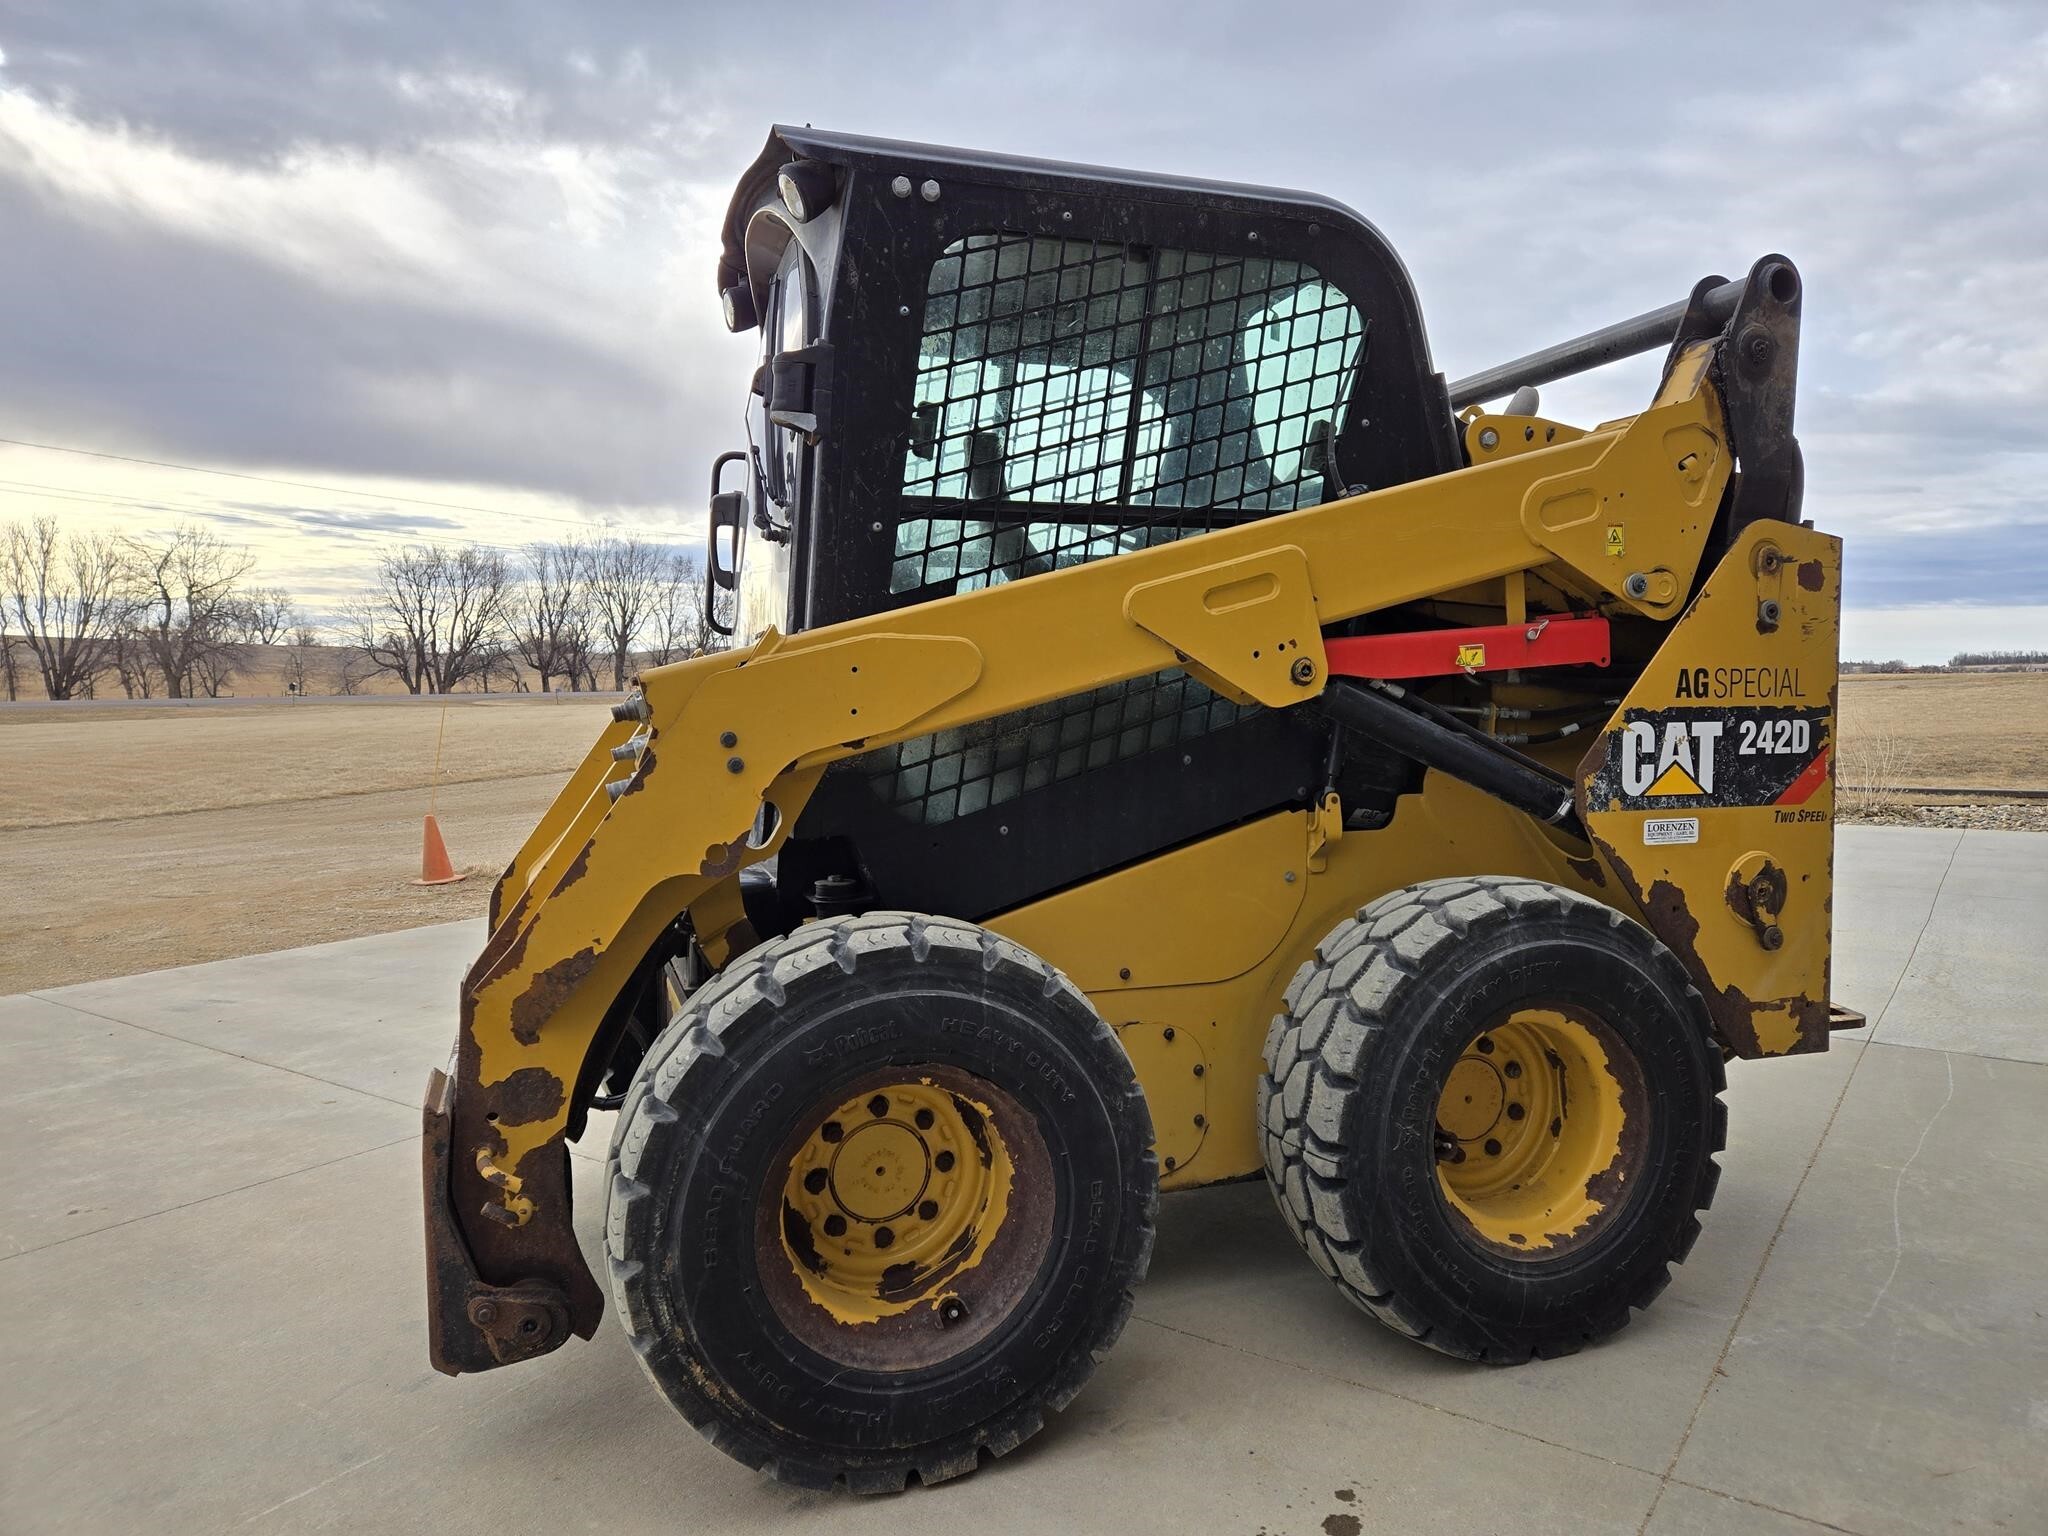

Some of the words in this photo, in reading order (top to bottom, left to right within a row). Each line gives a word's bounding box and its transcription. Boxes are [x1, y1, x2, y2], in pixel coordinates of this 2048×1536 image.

[1675, 668, 1709, 699] AG
[1714, 667, 1806, 698] SPECIAL
[1738, 719, 1810, 755] 242D
[1621, 720, 1723, 797] CAT
[1647, 822, 1695, 833] LORENZEN
[940, 1016, 1022, 1055] HEAVY
[1024, 1050, 1078, 1104] DUTY
